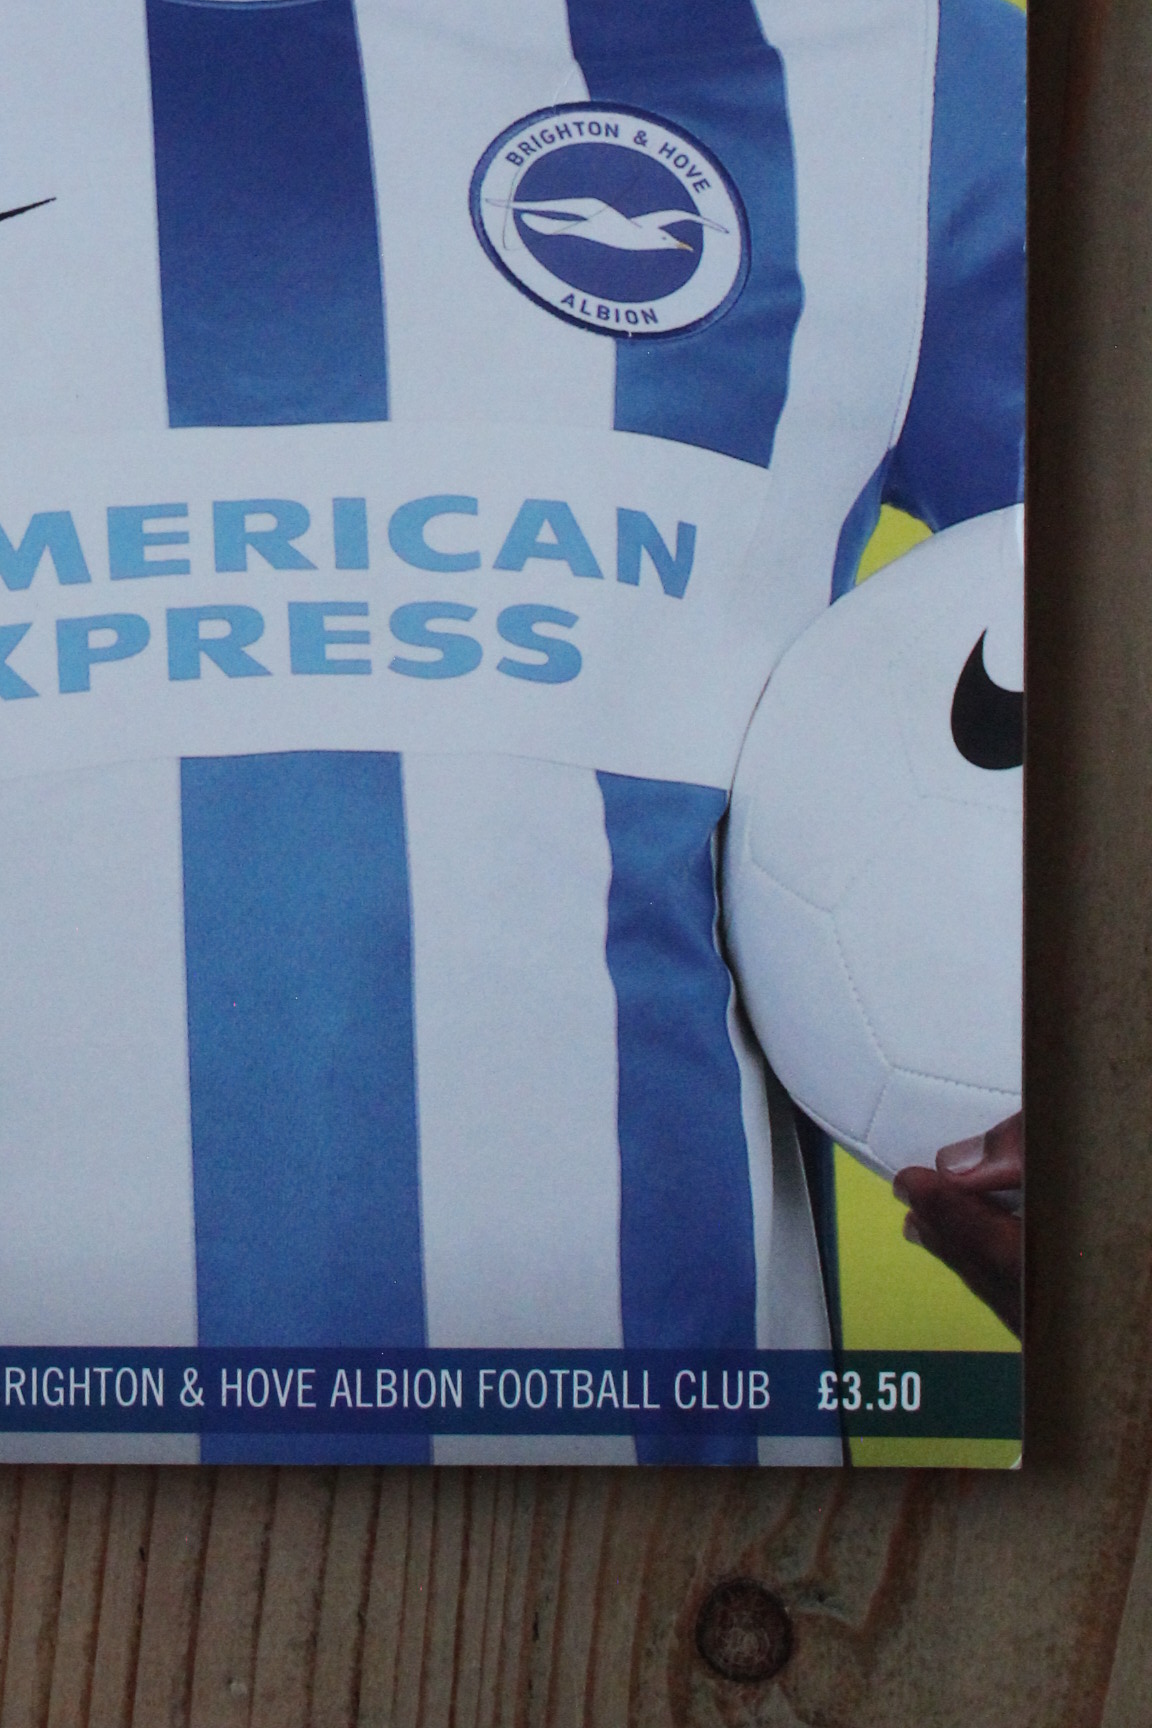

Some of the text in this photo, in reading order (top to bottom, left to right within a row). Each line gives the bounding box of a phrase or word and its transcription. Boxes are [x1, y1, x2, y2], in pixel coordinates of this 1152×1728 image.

[505, 120, 713, 194] BRIGHTON & HOVE
[560, 292, 659, 325] ALBION
[179, 1368, 206, 1407] &
[220, 1367, 317, 1408] HOVE
[329, 1368, 464, 1409] ALBION
[478, 1368, 661, 1409] FOOTBALL
[673, 1369, 771, 1410] CLUB
[817, 1370, 922, 1412] £3.50
